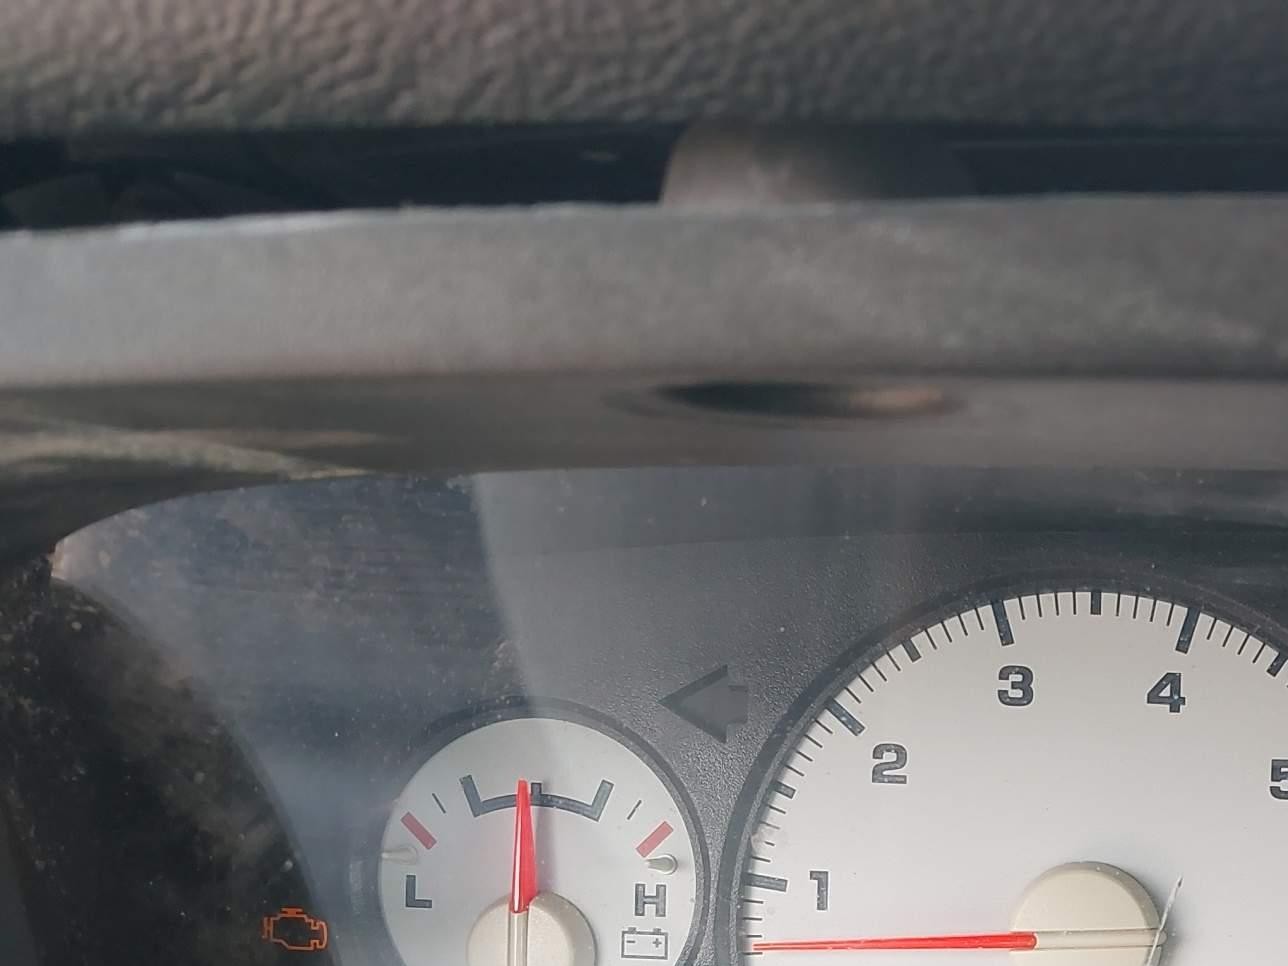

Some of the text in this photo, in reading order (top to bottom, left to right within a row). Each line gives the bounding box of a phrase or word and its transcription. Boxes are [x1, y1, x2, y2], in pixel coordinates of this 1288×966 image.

[998, 666, 1033, 706] 3
[1147, 673, 1185, 713] 4
[872, 743, 907, 784] 2
[405, 875, 432, 908] L
[635, 884, 666, 917] H
[810, 871, 828, 910] 1
